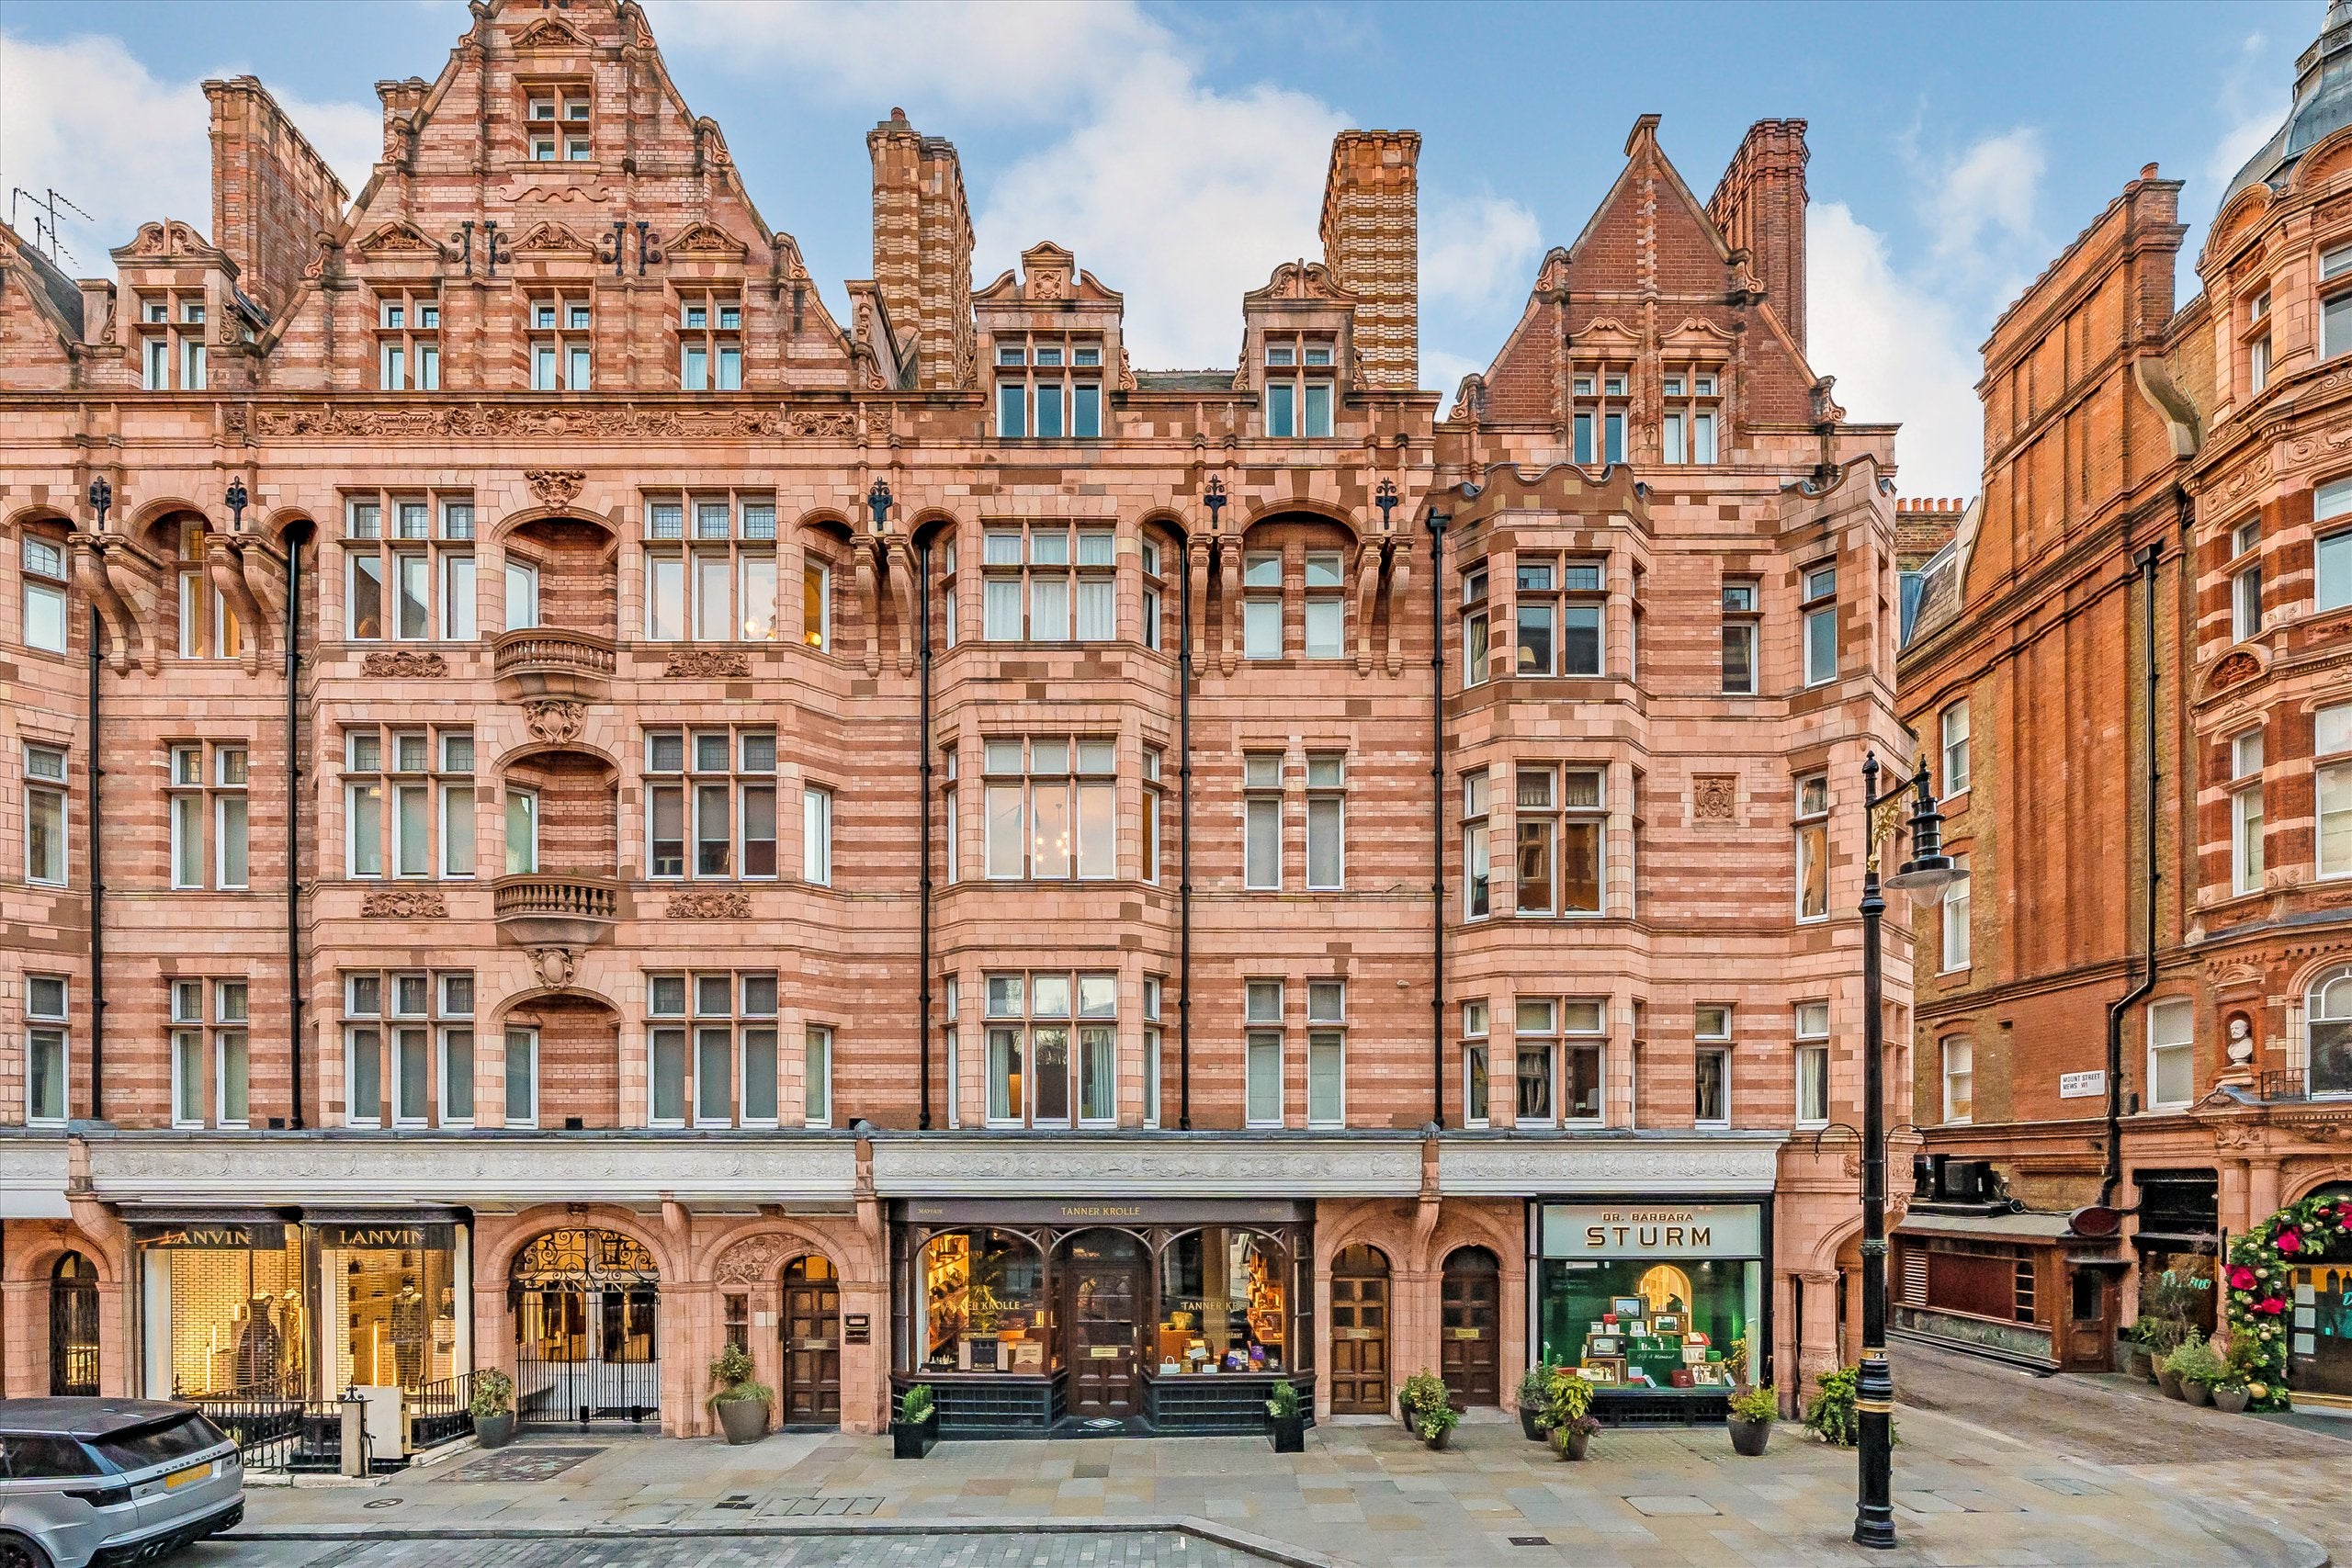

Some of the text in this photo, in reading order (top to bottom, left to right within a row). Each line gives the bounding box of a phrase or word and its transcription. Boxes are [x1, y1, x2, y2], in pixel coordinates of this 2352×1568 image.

[2082, 1073, 2100, 1081] STREET
[1061, 1207, 1140, 1216] TANNER KROLLE
[1601, 1213, 1694, 1222] DR. BARBARA
[164, 1231, 252, 1245] LANVIN
[339, 1231, 424, 1245] LANVIN
[1586, 1225, 1711, 1248] STURM
[981, 1301, 1020, 1310] KROLLE
[1182, 1302, 1223, 1311] TANNER
[156, 1450, 224, 1474] RANGE ROVER
